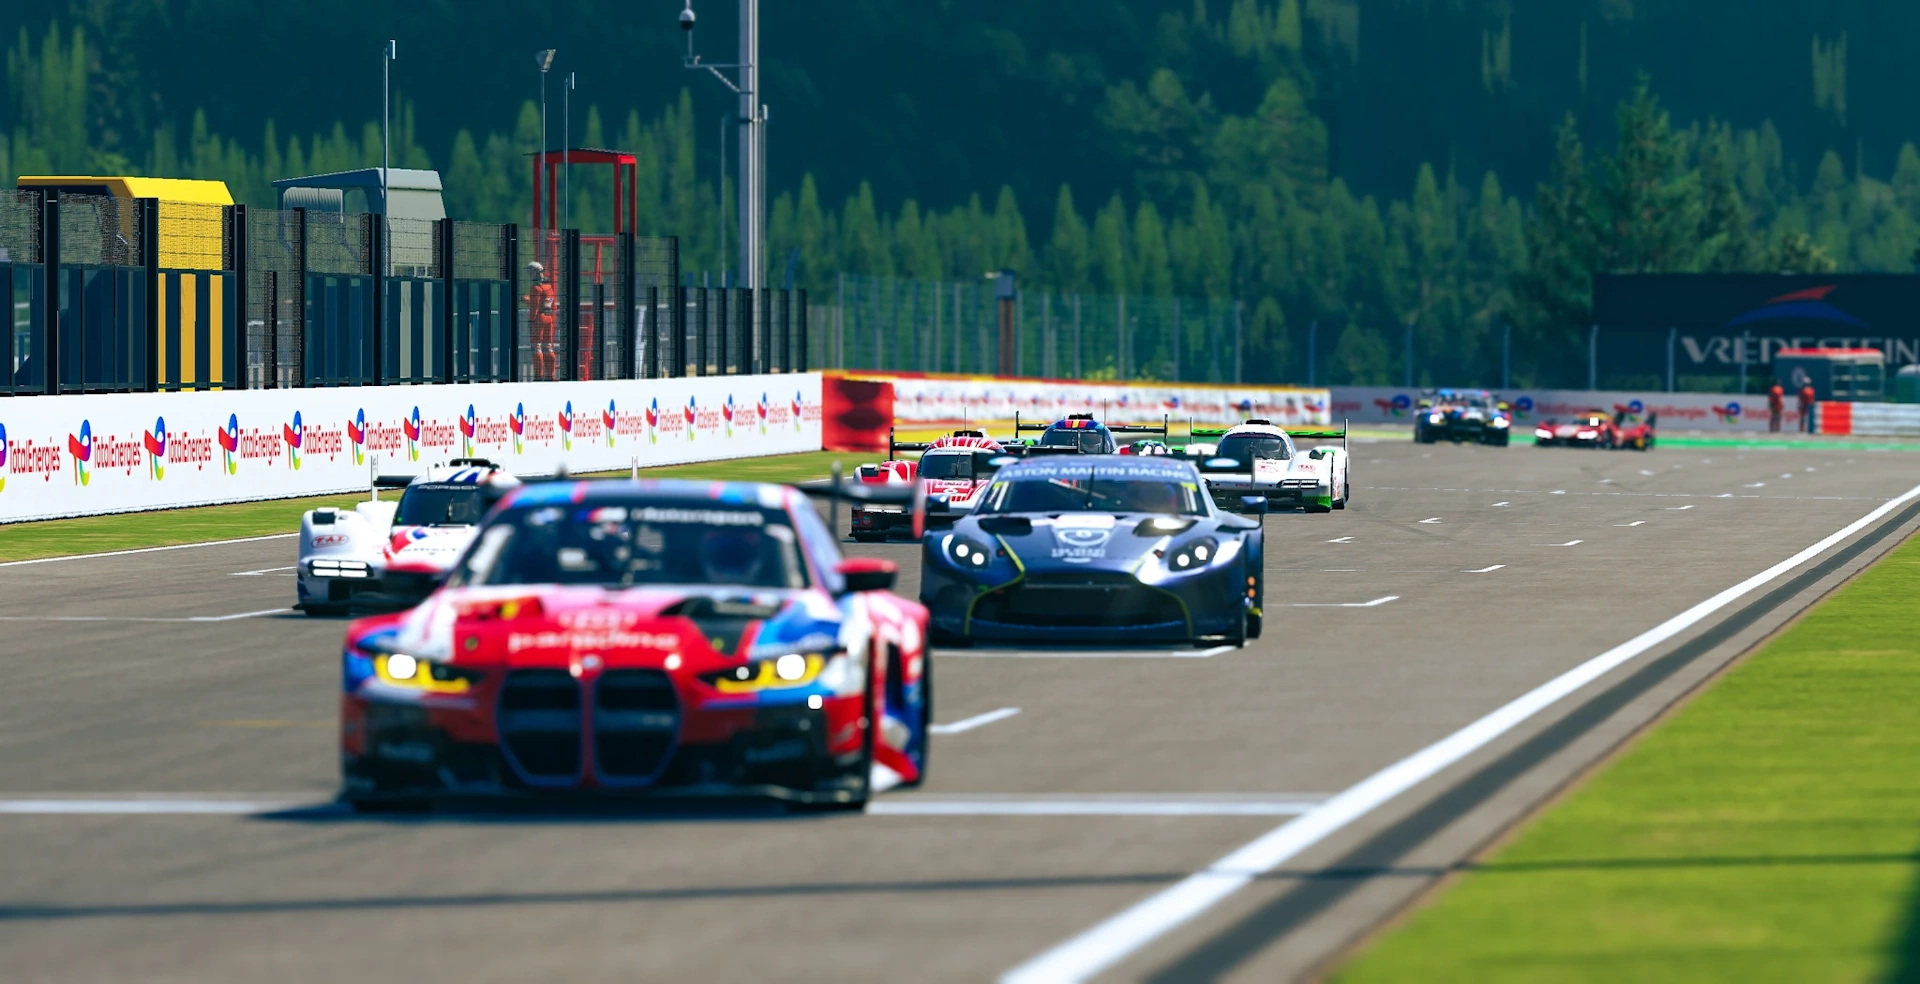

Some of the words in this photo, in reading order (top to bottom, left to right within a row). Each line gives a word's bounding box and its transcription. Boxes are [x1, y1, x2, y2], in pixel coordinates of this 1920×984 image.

[166, 429, 212, 471] TotalEnergies
[239, 425, 281, 466] TotalEnergies
[302, 422, 343, 461] TotalEnergies
[365, 420, 402, 458] TotalEnergies
[420, 416, 455, 454] TotalEnergies
[475, 414, 508, 450] TotalEnergies
[8, 438, 61, 482] TotalEnergies
[92, 434, 142, 477] TotalEnergies
[1002, 467, 1057, 479] ASTON
[1060, 466, 1125, 477] MARTIN
[1129, 467, 1192, 479] RACING
